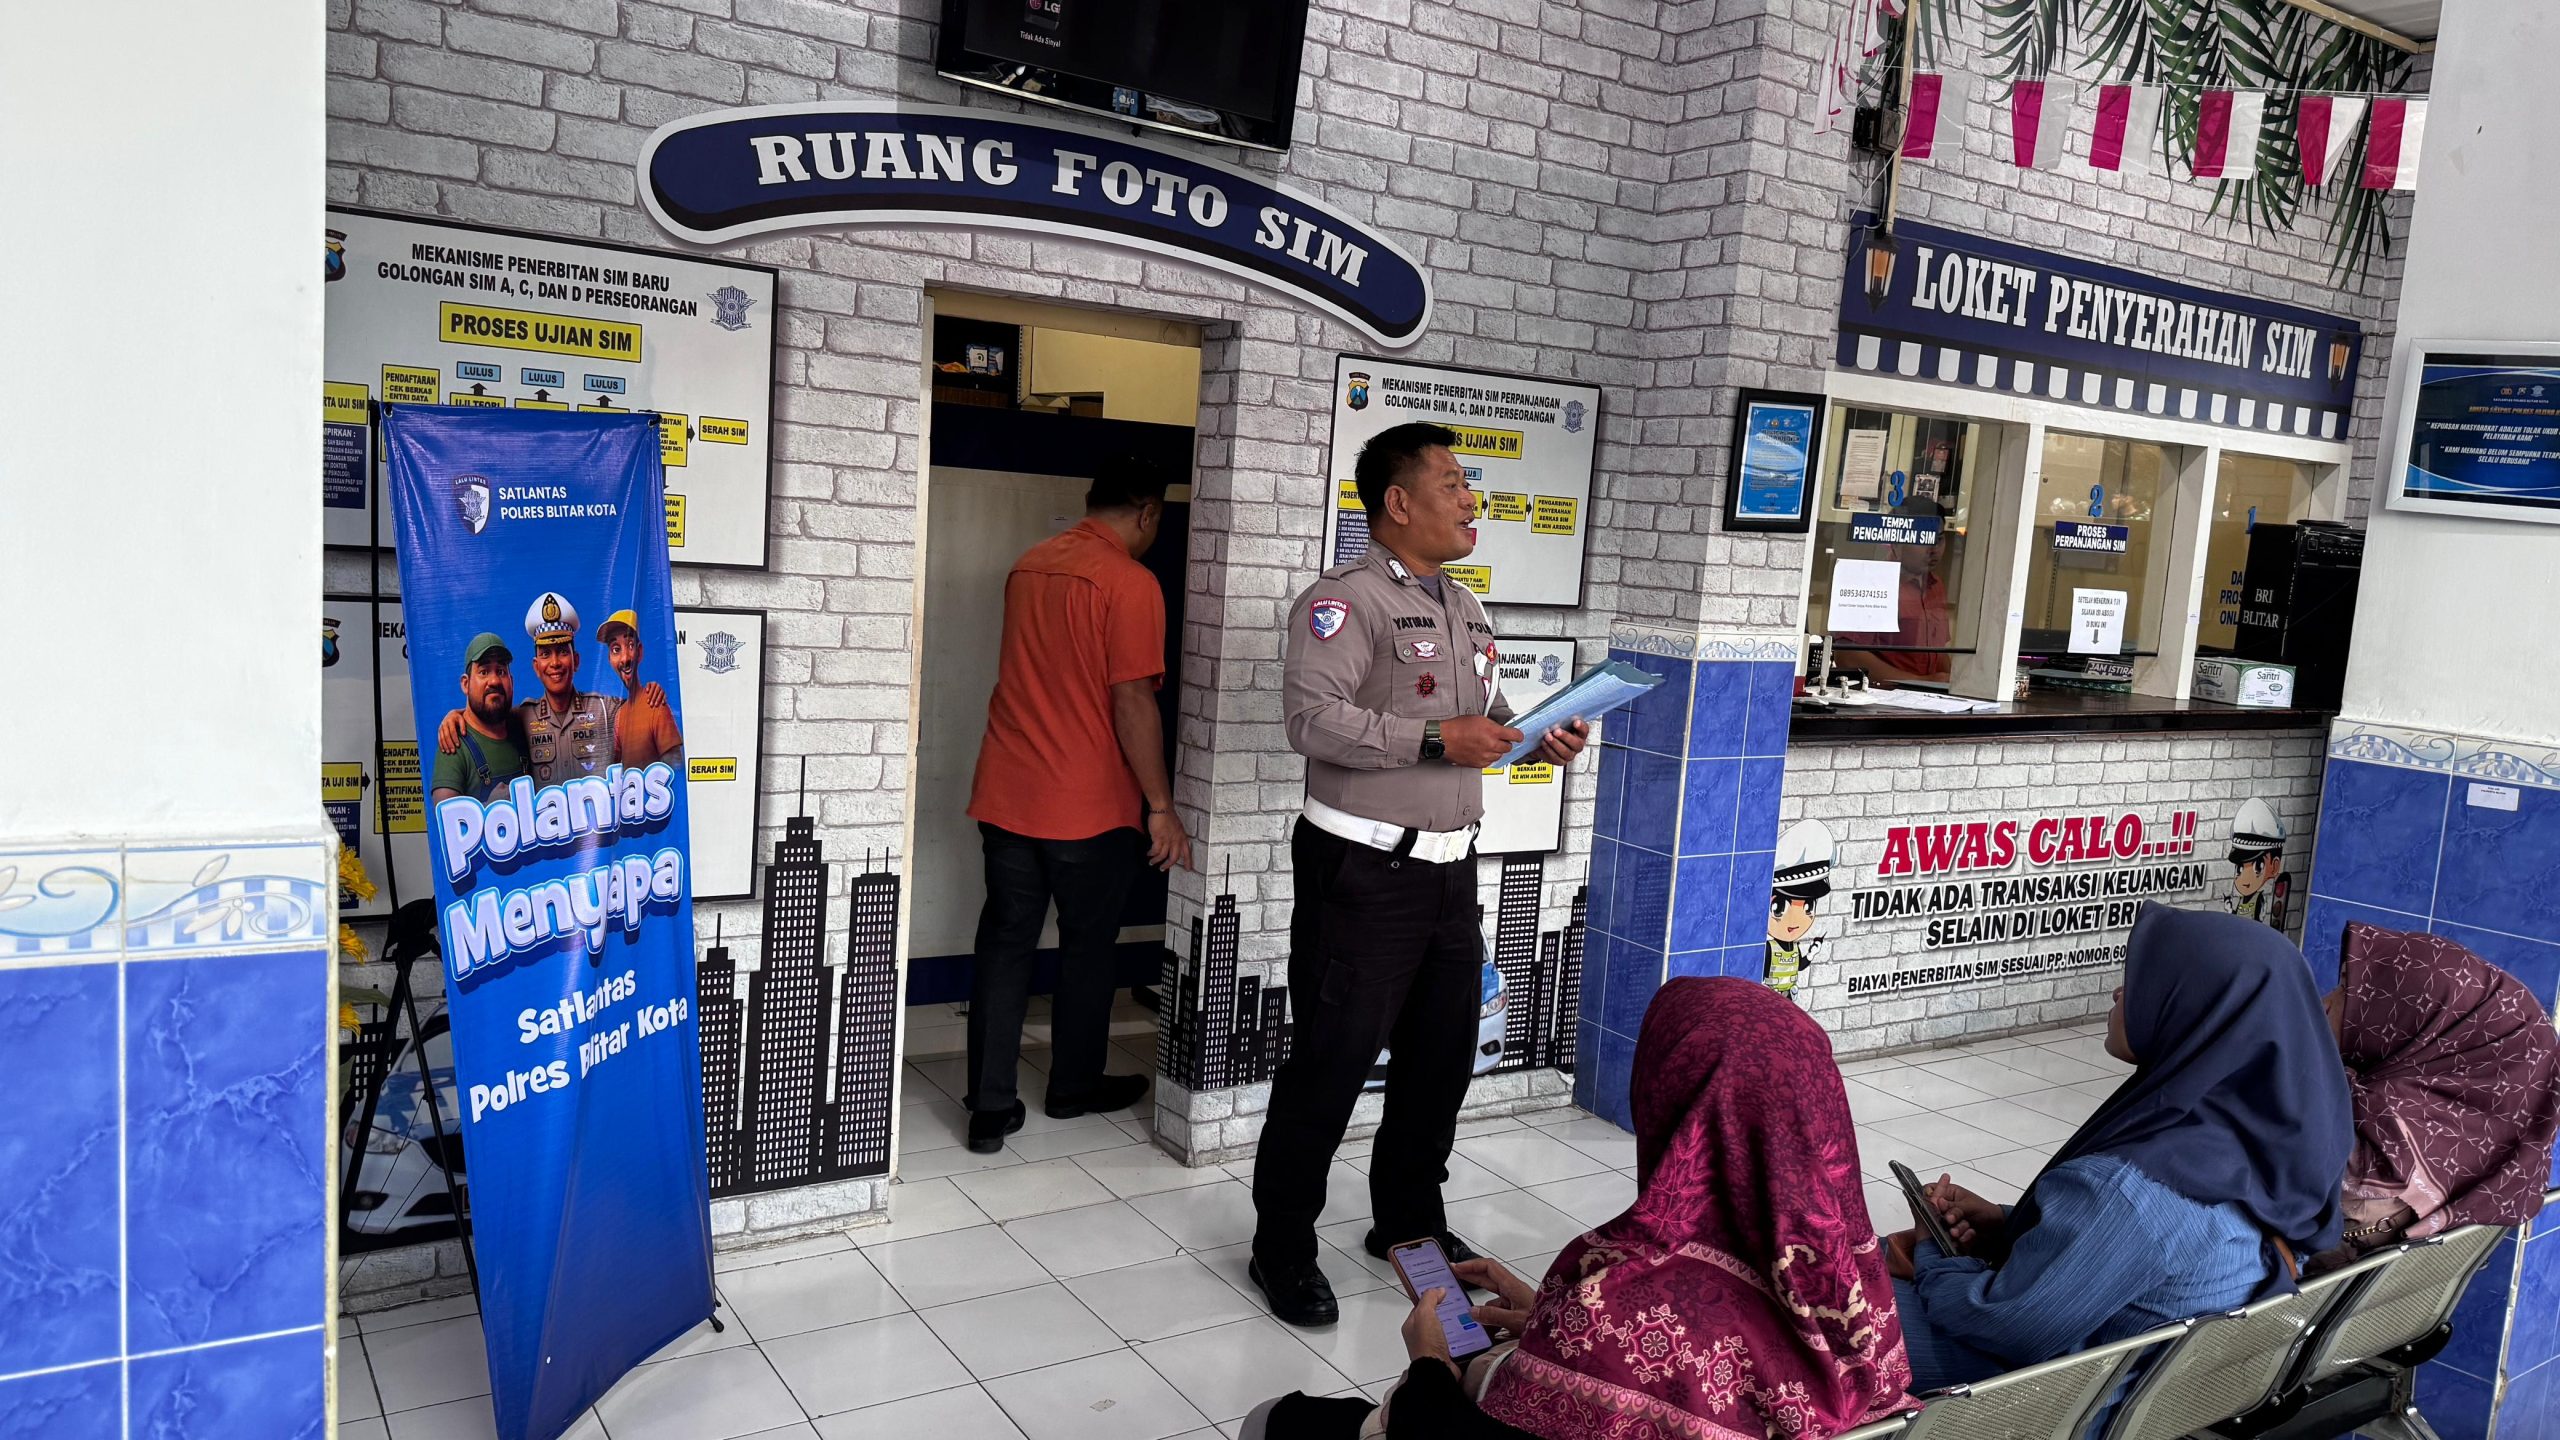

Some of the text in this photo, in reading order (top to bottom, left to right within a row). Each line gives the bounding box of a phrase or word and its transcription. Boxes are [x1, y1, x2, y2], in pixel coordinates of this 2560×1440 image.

[1020, 31, 1060, 48] Tidak Ada Sinyal
[750, 132, 1368, 287] RUANG FOTO SIM
[412, 243, 670, 292] MEKANISME PENERBITAN SIM BARU
[378, 262, 697, 316] GOLONGAN SIM A, C, DAN D PERSEORANGAN
[1912, 247, 2317, 378] LOKET PENYERAHAN SIM
[451, 313, 632, 351] PROSES UJIAN SIM
[385, 372, 436, 385] PENDAFTARAN
[464, 366, 493, 377] LULUS
[528, 372, 557, 383] LULUS
[405, 386, 432, 394] BERKAS
[591, 379, 618, 390] LULUS
[1382, 378, 1560, 409] MEKANISME PENERBITAN SIM PERPANJANGAN
[338, 397, 350, 409] UJI
[352, 398, 365, 410] SIM
[1385, 395, 1555, 424] GOLONGAN SIM A, C, DAN D PERSEORANGAN
[702, 424, 745, 437] SERAH SIM
[1466, 433, 1496, 450] UJIAN
[1499, 437, 1517, 452] SIM
[499, 487, 566, 500] SATLANTAS
[1888, 471, 1904, 506] 3
[2089, 484, 2104, 517] 2
[501, 504, 617, 519] POLRES BLITAR KOTA
[1881, 516, 1914, 529] TEMPAT
[2077, 524, 2107, 538] PROSES
[1853, 526, 1936, 545] PENGAMBILAN SIM
[2055, 535, 2126, 551] PERPANJANGAN SIM
[2255, 589, 2274, 603] BRI
[2242, 610, 2280, 628] BLITAR
[2090, 663, 2107, 672] JAM
[2108, 666, 2133, 675] ISTIRA
[2198, 662, 2223, 676] Santri
[2257, 671, 2280, 681] Santri
[532, 735, 553, 745] IWAN
[332, 777, 359, 787] UJI SIM
[438, 764, 673, 880] Polantas
[1878, 821, 2017, 875] AWAS
[1852, 864, 2206, 919] TIDAK ADA TRANSAKSI KEUANGAN
[445, 849, 682, 979] Menyapa
[1927, 914, 2007, 946] SELAIN
[2012, 911, 2036, 937] DI
[2040, 905, 2104, 934] LOKET
[1848, 944, 2126, 992] BIAYA PENERBITAN SIM SESUAI PP. NOMOR 60
[517, 970, 636, 1044] Satlantas
[469, 998, 688, 1123] Polres Blitar Kota
